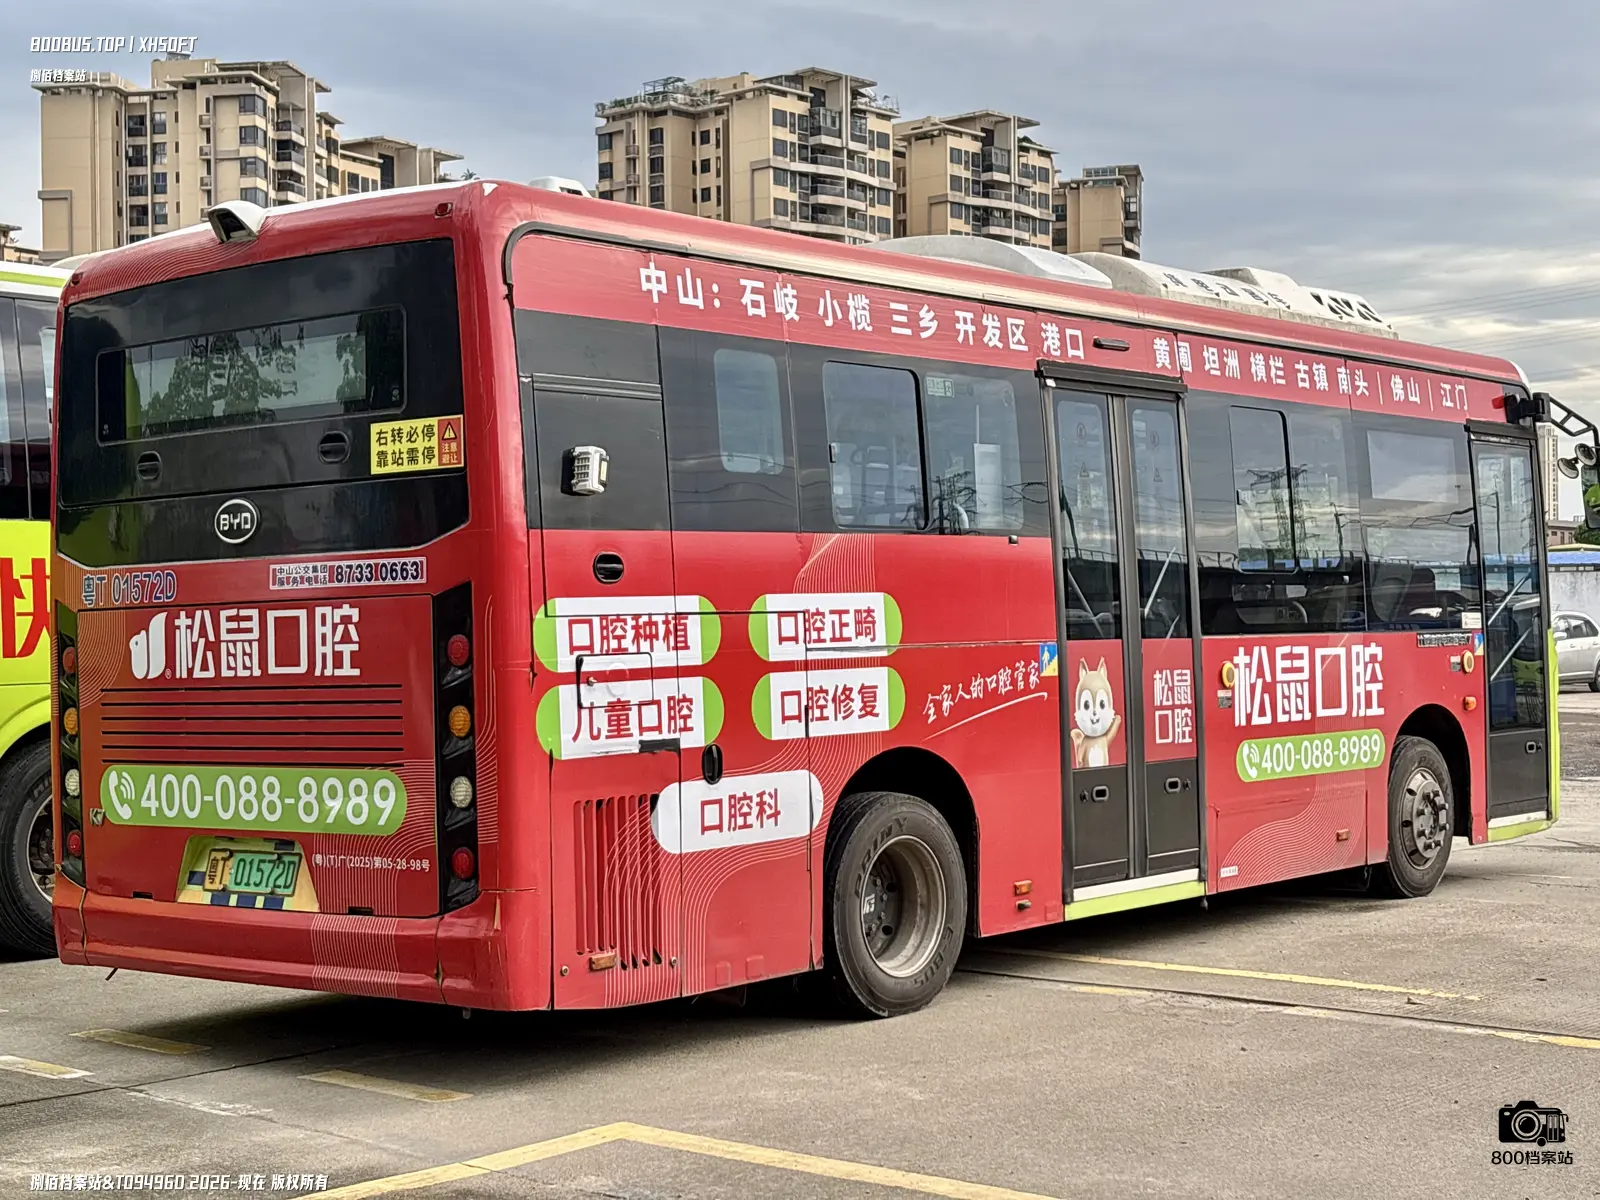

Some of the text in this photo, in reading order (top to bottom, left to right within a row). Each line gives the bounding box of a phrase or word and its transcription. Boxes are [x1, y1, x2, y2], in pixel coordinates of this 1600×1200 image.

[739, 278, 800, 322] 石岐
[818, 290, 873, 332] 小榄
[889, 302, 938, 339] 三乡
[954, 310, 1029, 352] 开发区
[1041, 321, 1085, 360] 港口
[1153, 337, 1192, 373] 黄圃
[1203, 344, 1241, 380] 坦洲
[1250, 351, 1286, 385] 横栏
[1294, 359, 1329, 392] 古镇
[1336, 366, 1370, 397] 南头
[1390, 373, 1421, 405] 佛山
[1440, 381, 1468, 411] 江门
[375, 423, 436, 447] 右转必停
[376, 445, 436, 469] 靠站需停
[220, 512, 251, 531] BYD
[111, 570, 177, 605] 01572D
[277, 564, 328, 575] 中山公交集团
[277, 575, 328, 587] 服务电话
[335, 560, 420, 584] 8733 0663
[173, 604, 361, 679] 松鼠口腔
[567, 613, 691, 656] 口腔种植
[776, 606, 877, 646] 口腔正畸
[780, 683, 880, 725] 口腔修复
[922, 659, 1040, 724] 全家人的口腔管家
[1153, 669, 1192, 706] 松鼠
[1233, 642, 1385, 727] 松鼠口腔
[571, 693, 695, 743] 儿童口腔
[1155, 707, 1193, 744] 口腔
[1261, 733, 1381, 774] 400-088-8989
[140, 773, 396, 826] 400-088-8989
[700, 788, 781, 836] 口腔科
